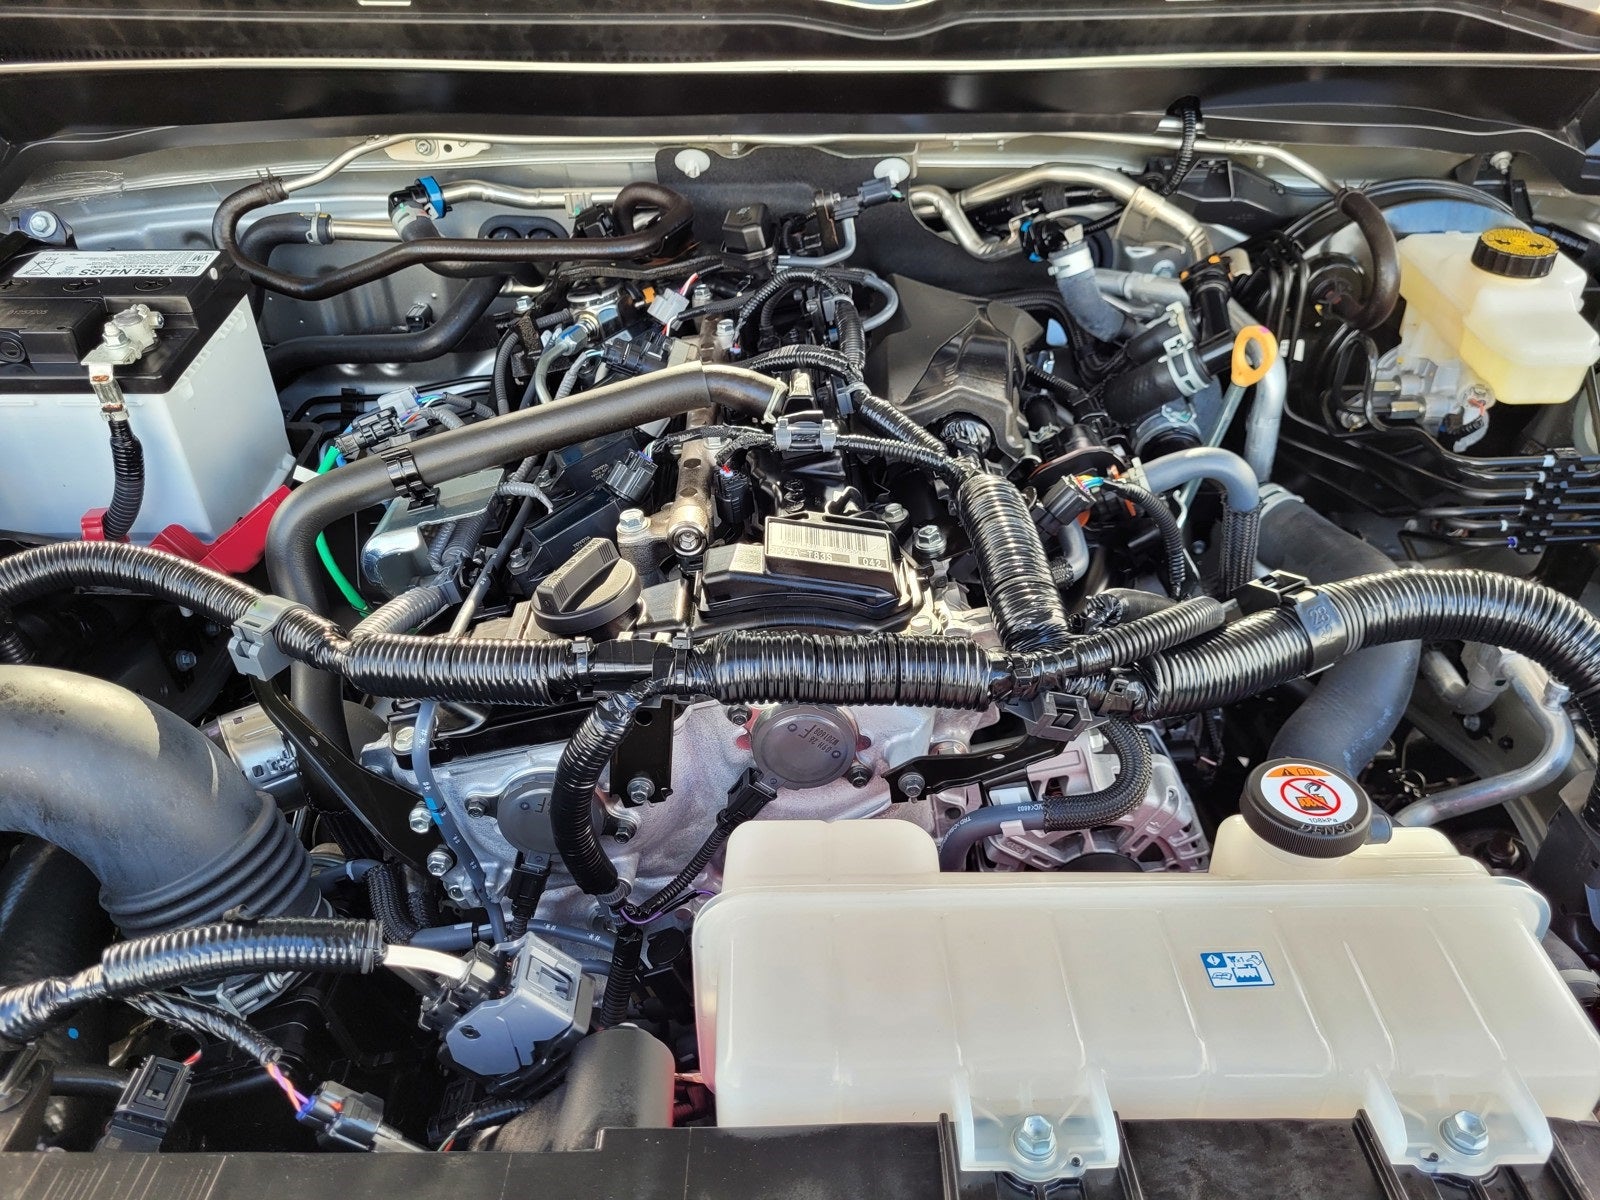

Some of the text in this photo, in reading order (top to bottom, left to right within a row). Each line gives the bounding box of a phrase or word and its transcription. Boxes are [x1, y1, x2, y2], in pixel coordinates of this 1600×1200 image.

[79, 267, 170, 276] 395LN4-ISS
[862, 557, 883, 569] 042
[1308, 605, 1330, 631] 28
[1298, 821, 1355, 836] DENSO
